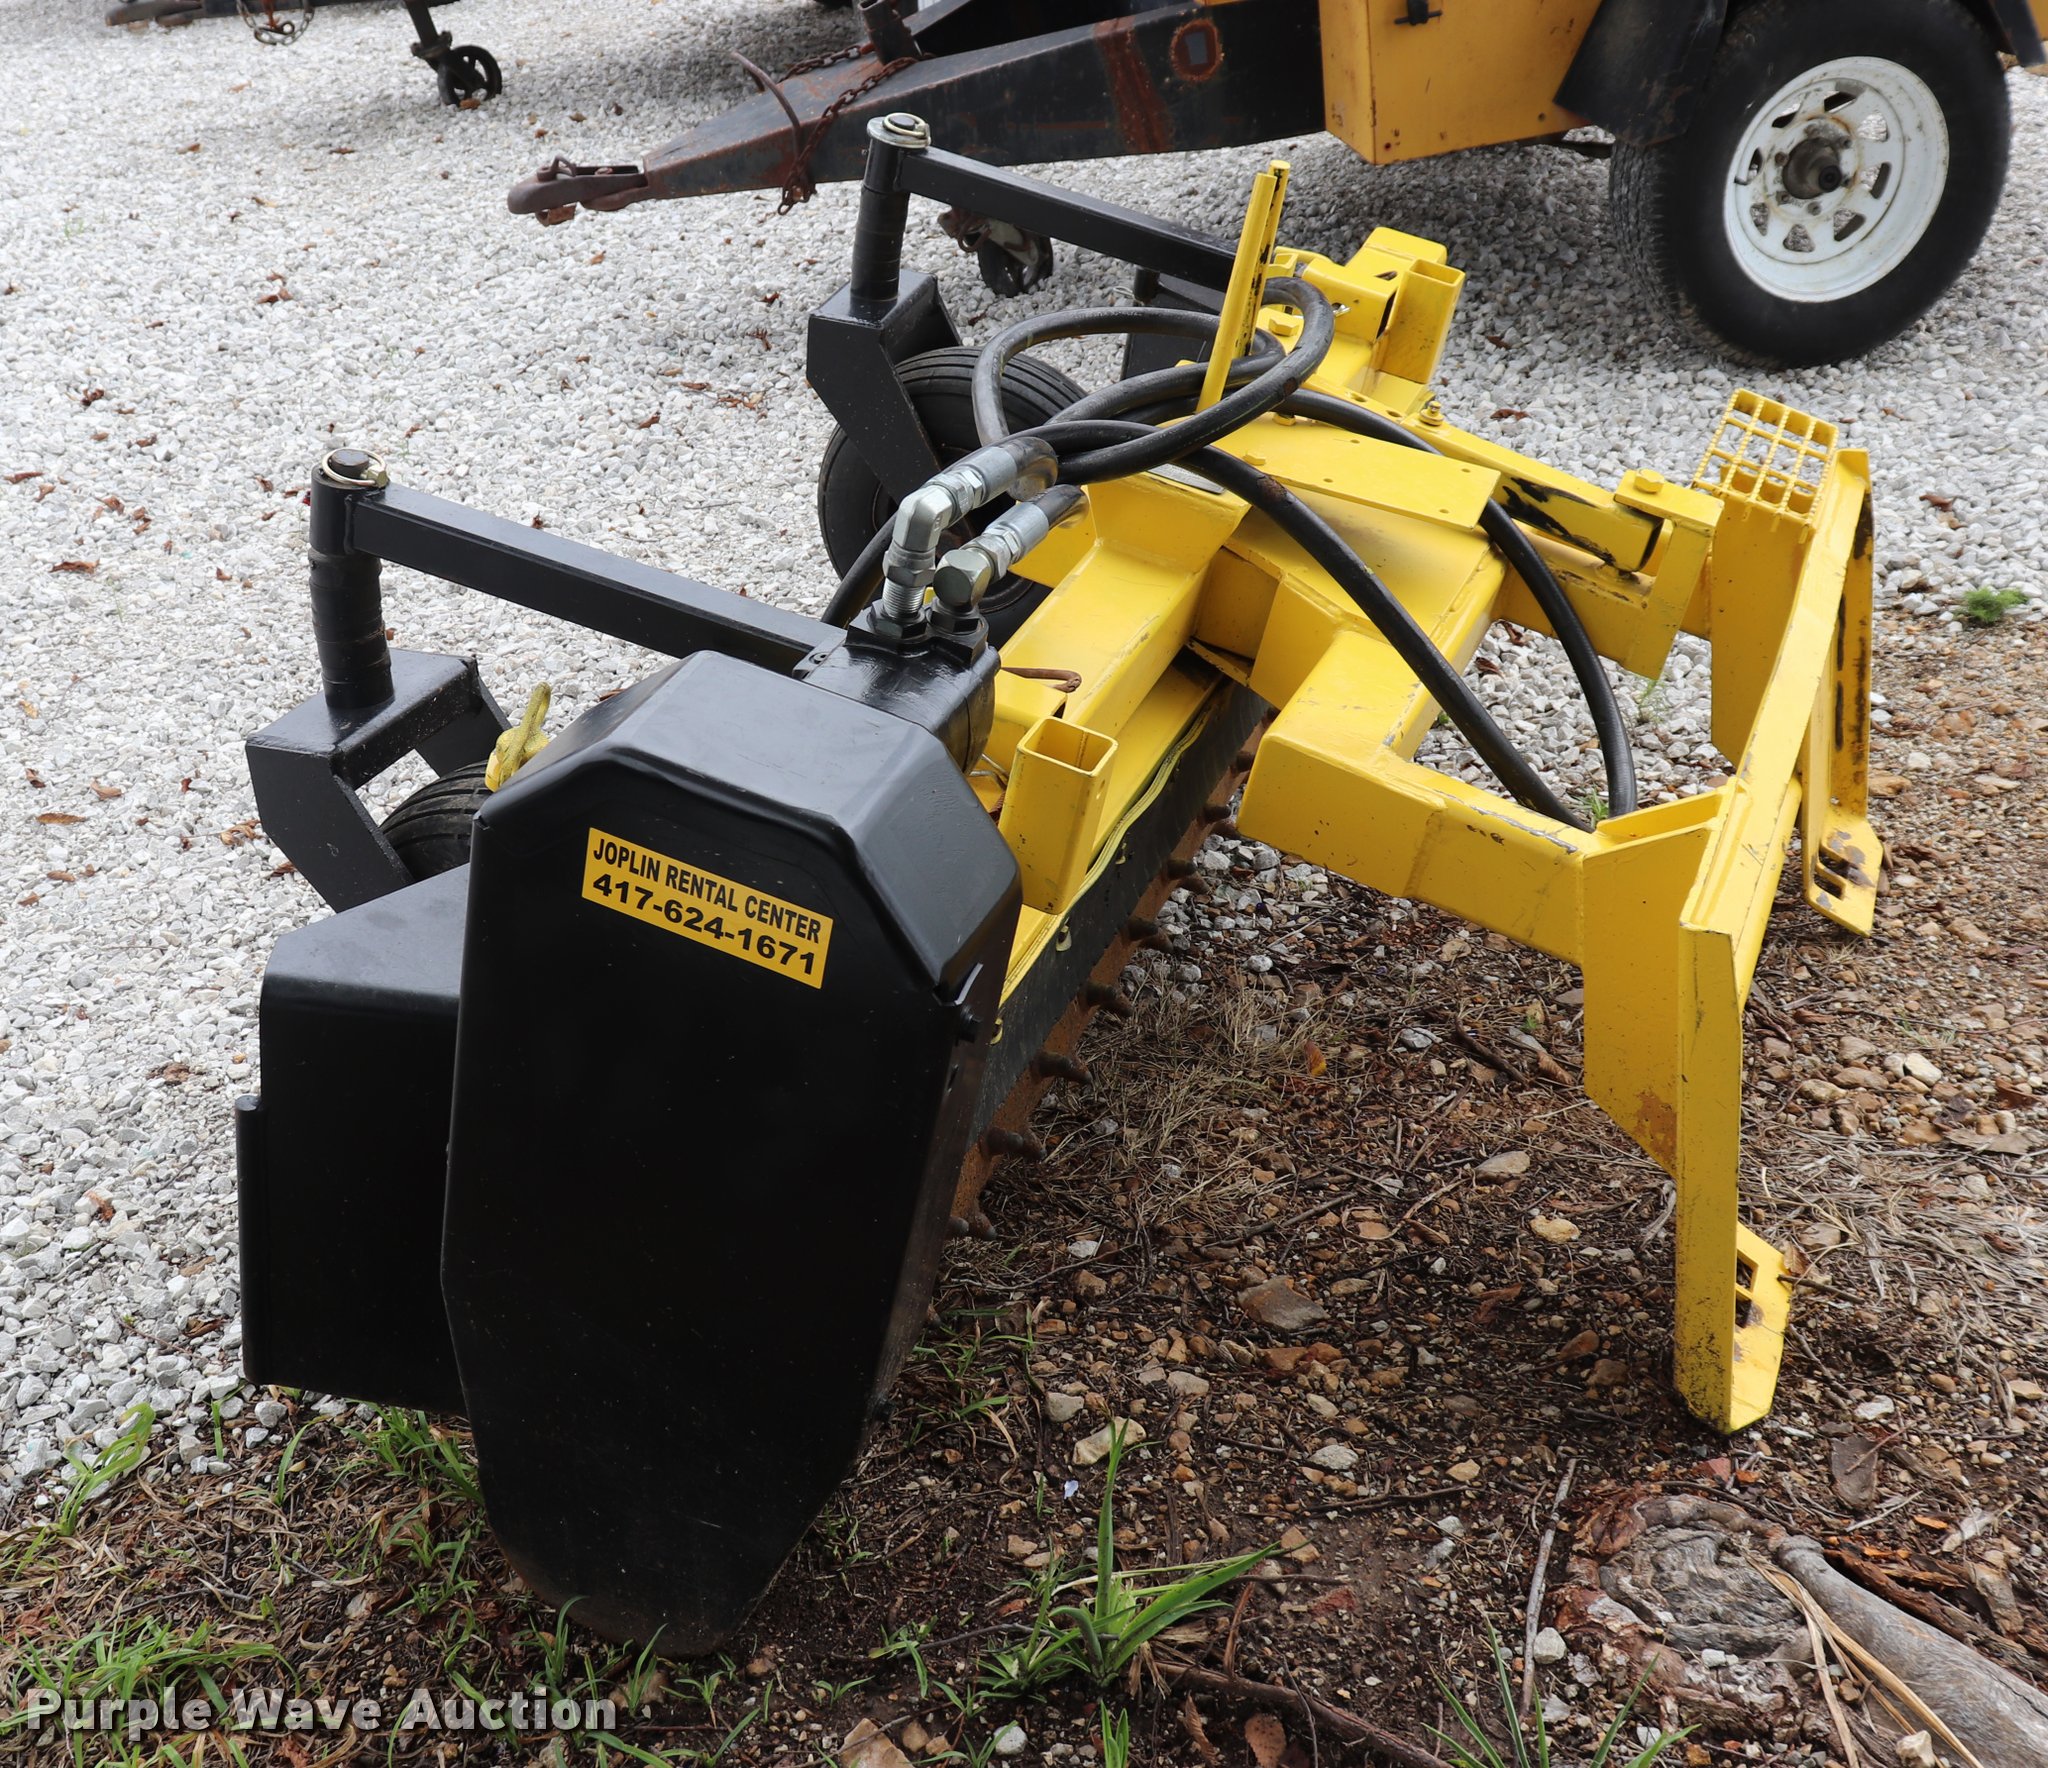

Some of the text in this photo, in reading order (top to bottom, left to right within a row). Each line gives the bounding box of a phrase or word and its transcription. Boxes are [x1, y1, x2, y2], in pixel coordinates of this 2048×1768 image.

[593, 838, 821, 943] JOPLIN RENTAL CENTER
[593, 873, 816, 975] 417-624-1671
